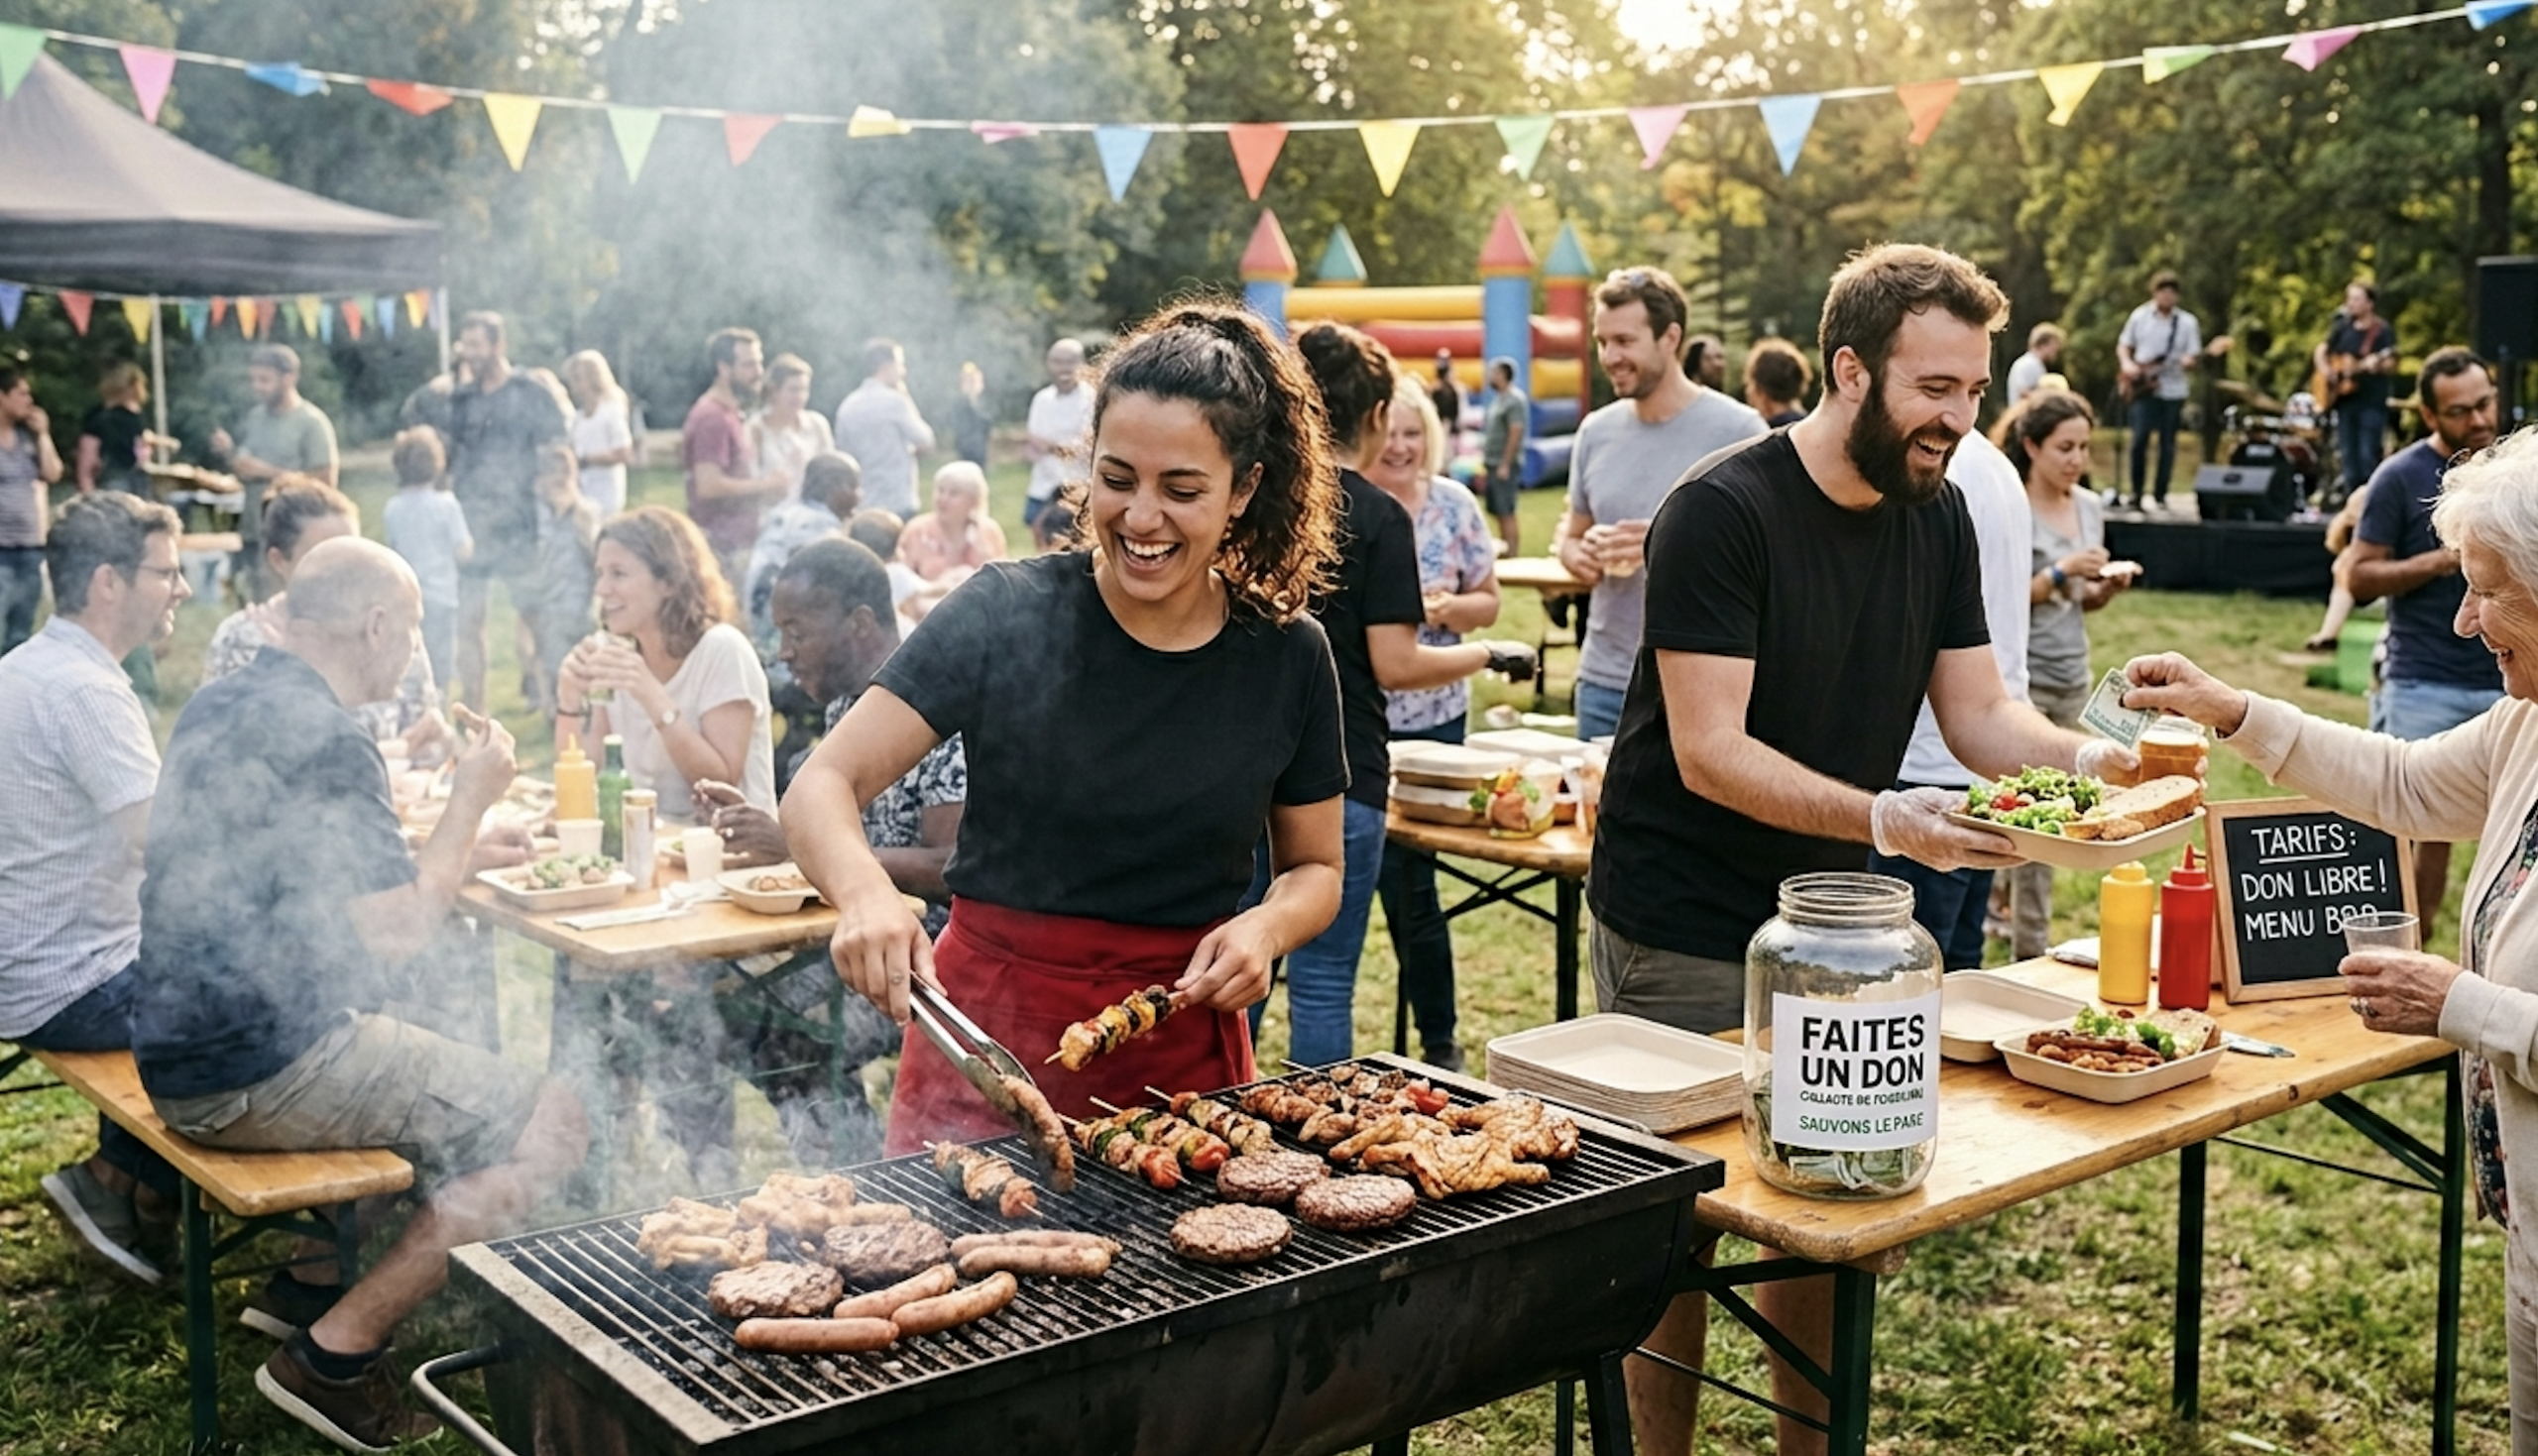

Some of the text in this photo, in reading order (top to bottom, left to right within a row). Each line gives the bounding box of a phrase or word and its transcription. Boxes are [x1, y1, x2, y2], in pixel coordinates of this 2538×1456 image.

[2241, 871, 2294, 902] DON
[2245, 908, 2314, 942] MENU
[1801, 1014, 1925, 1053] FAITES
[1800, 1052, 1924, 1088] UN DON
[1799, 1115, 1871, 1134] SAUVONS
[1876, 1117, 1892, 1134] LE
